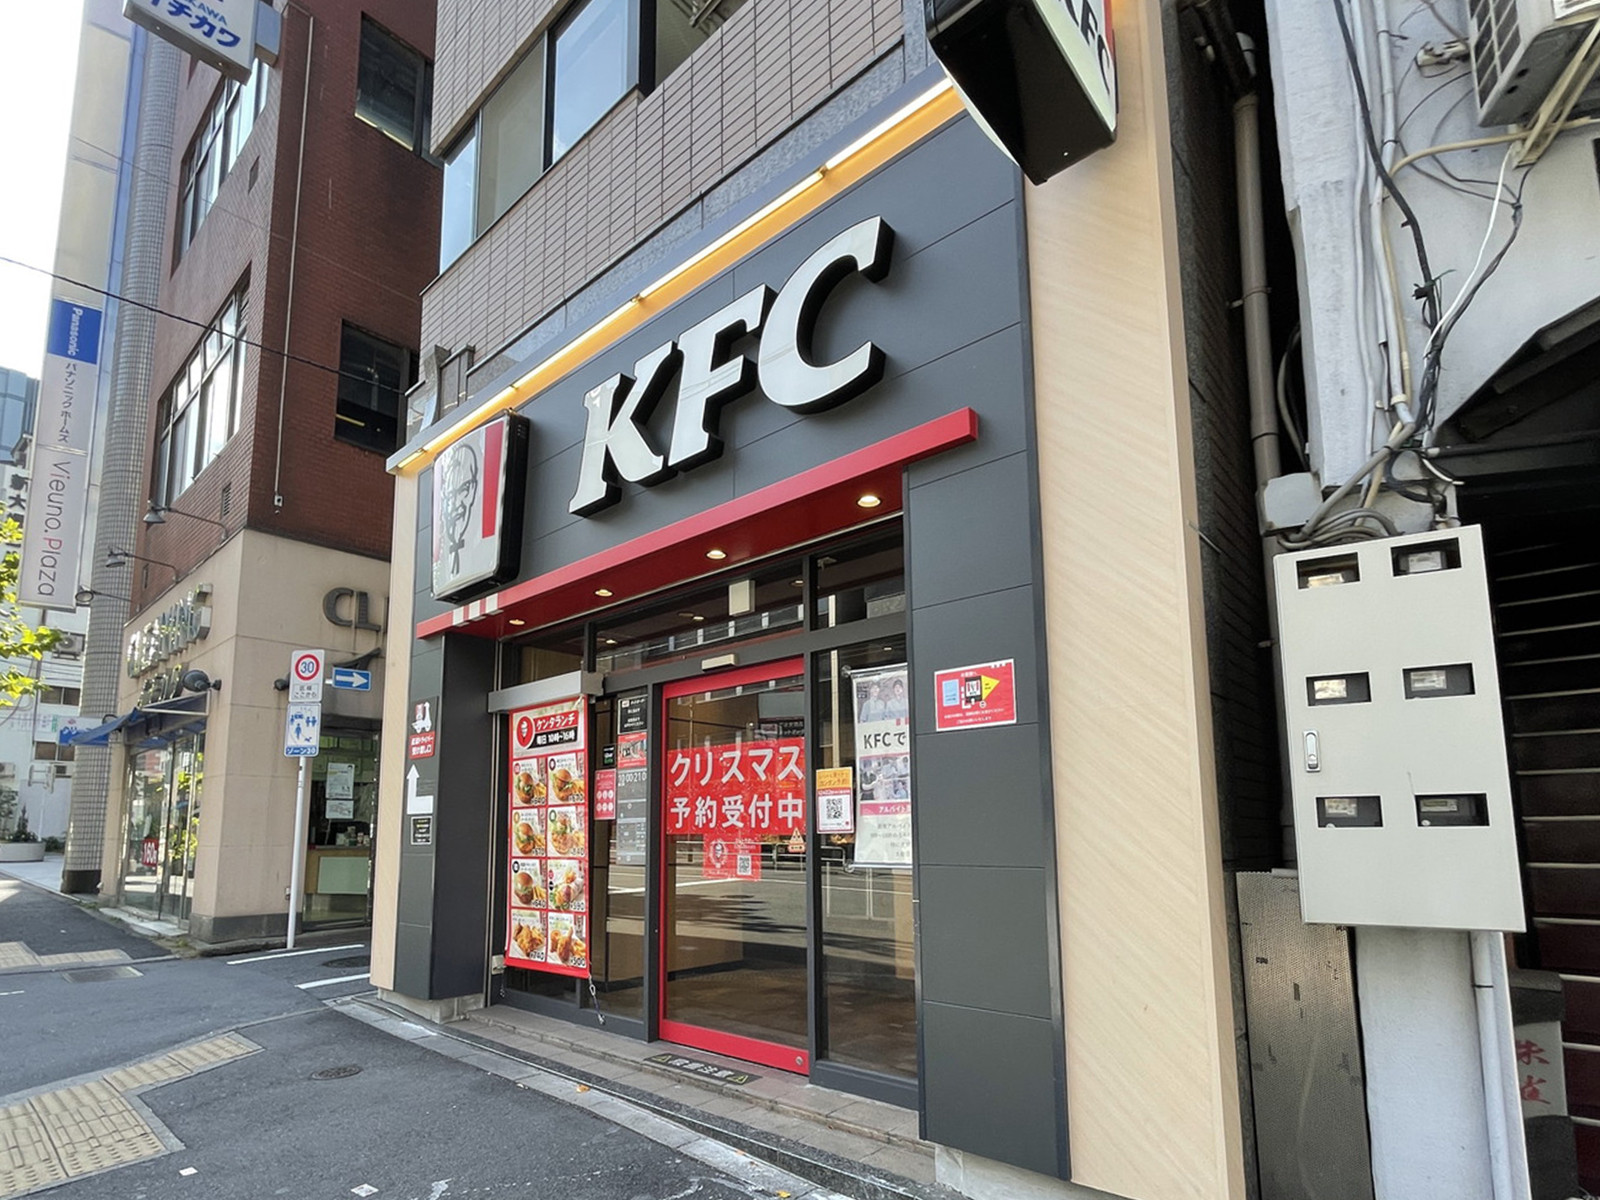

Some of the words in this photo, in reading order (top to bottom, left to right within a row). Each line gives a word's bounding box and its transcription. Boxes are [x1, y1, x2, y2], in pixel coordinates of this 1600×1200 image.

[67, 306, 84, 357] Panasonic
[568, 215, 892, 517] KFC
[322, 587, 388, 633] CL
[300, 660, 315, 674] 30
[535, 712, 576, 730] ケンタランチ
[863, 731, 907, 750] KFCで
[670, 745, 805, 787] クリスマス
[670, 792, 804, 829] 予約受付中
